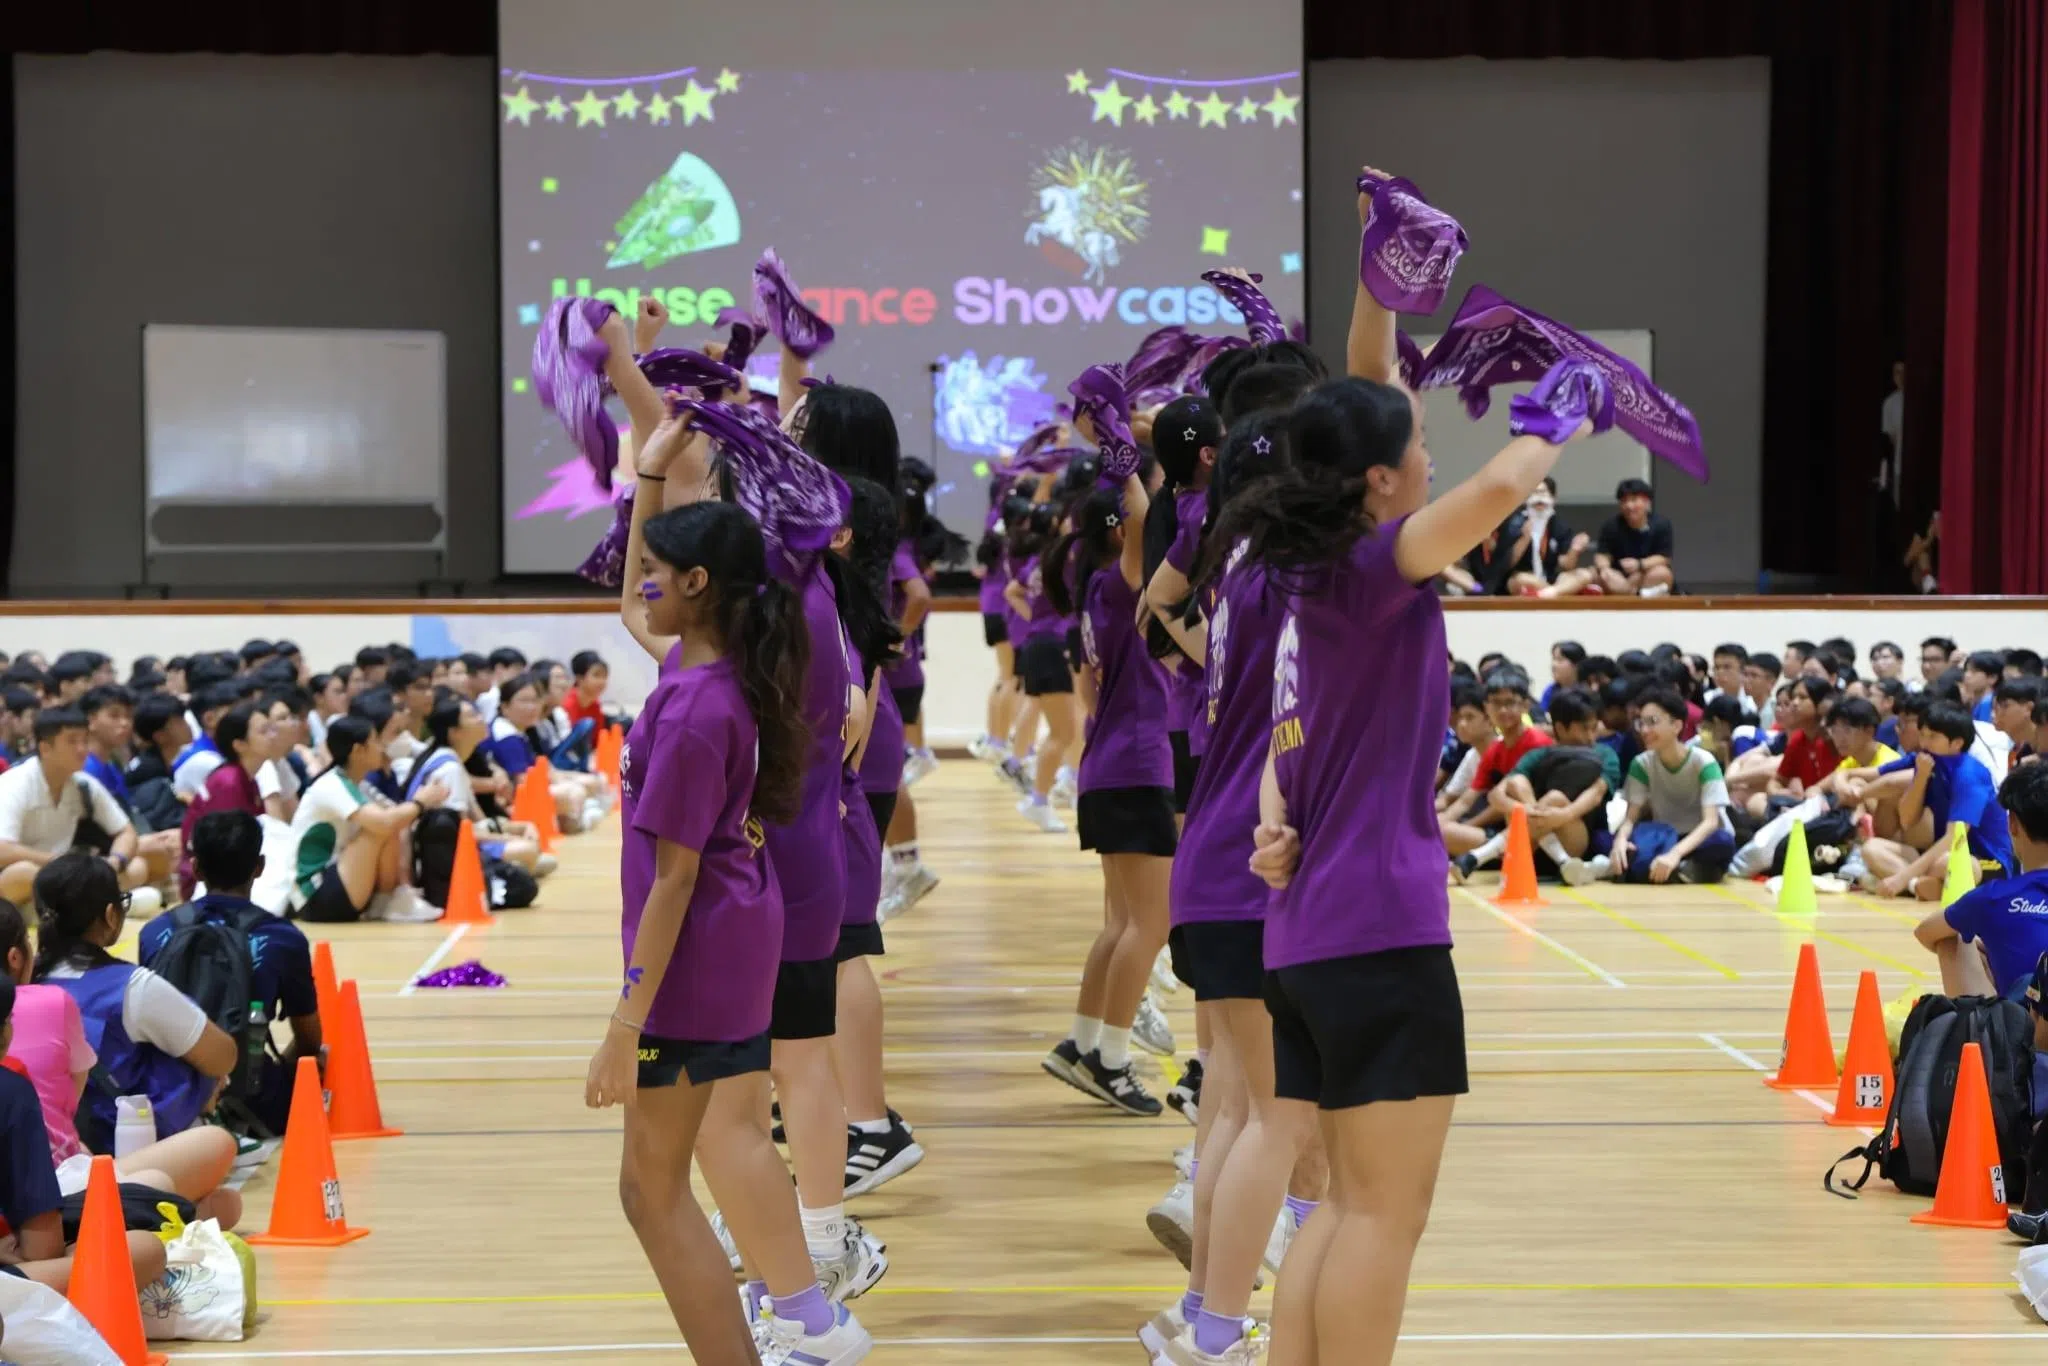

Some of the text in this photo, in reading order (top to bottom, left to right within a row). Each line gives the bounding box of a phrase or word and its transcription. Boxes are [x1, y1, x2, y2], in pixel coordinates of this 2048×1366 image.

[801, 288, 938, 326] ance
[2008, 897, 2048, 914] Stude
[1860, 1076, 1881, 1089] 15
[1855, 1094, 1883, 1107] J 2
